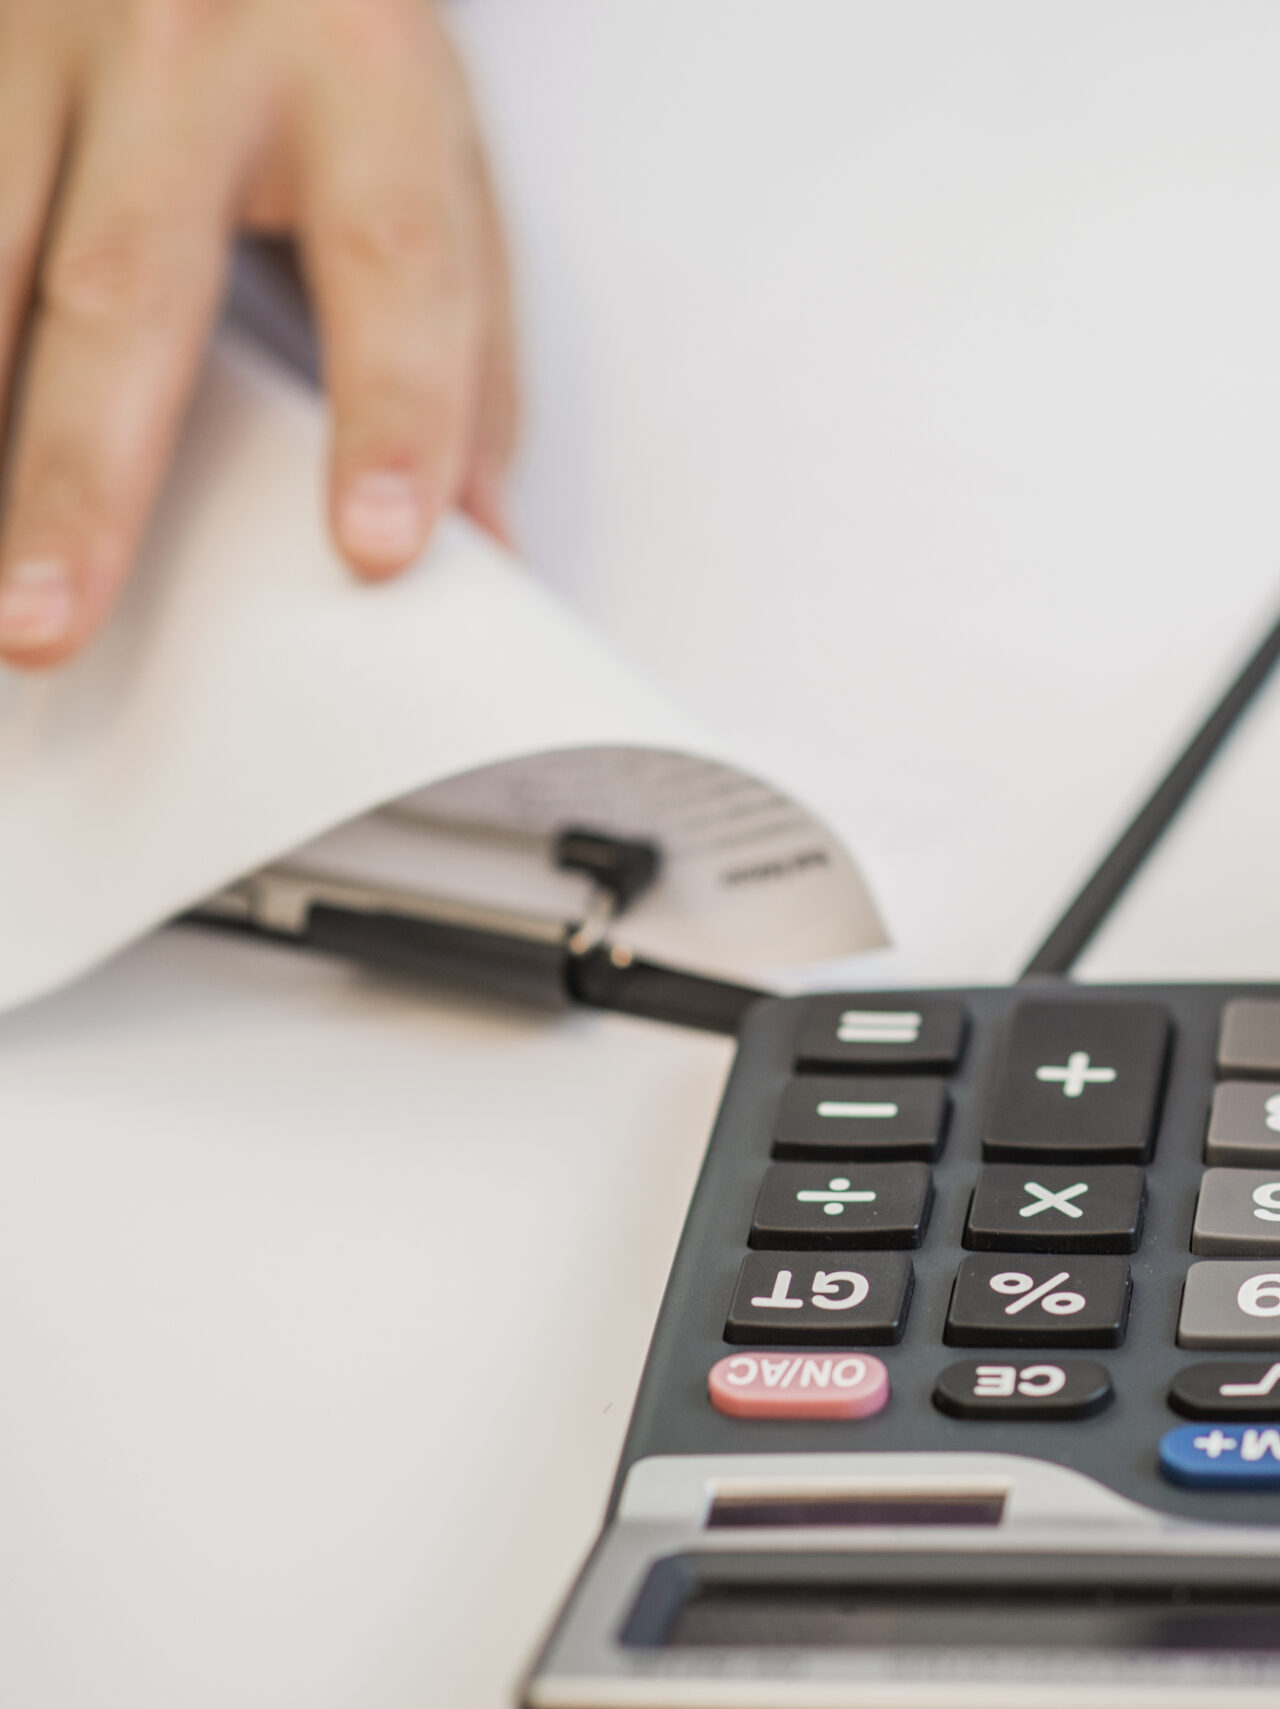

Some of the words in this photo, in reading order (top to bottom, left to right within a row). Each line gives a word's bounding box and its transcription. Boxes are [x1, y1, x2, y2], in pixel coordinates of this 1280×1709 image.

[750, 1270, 869, 1310] GT
[990, 1272, 1086, 1315] %
[726, 1356, 868, 1391] ON/AC
[973, 1364, 1066, 1397] CE
